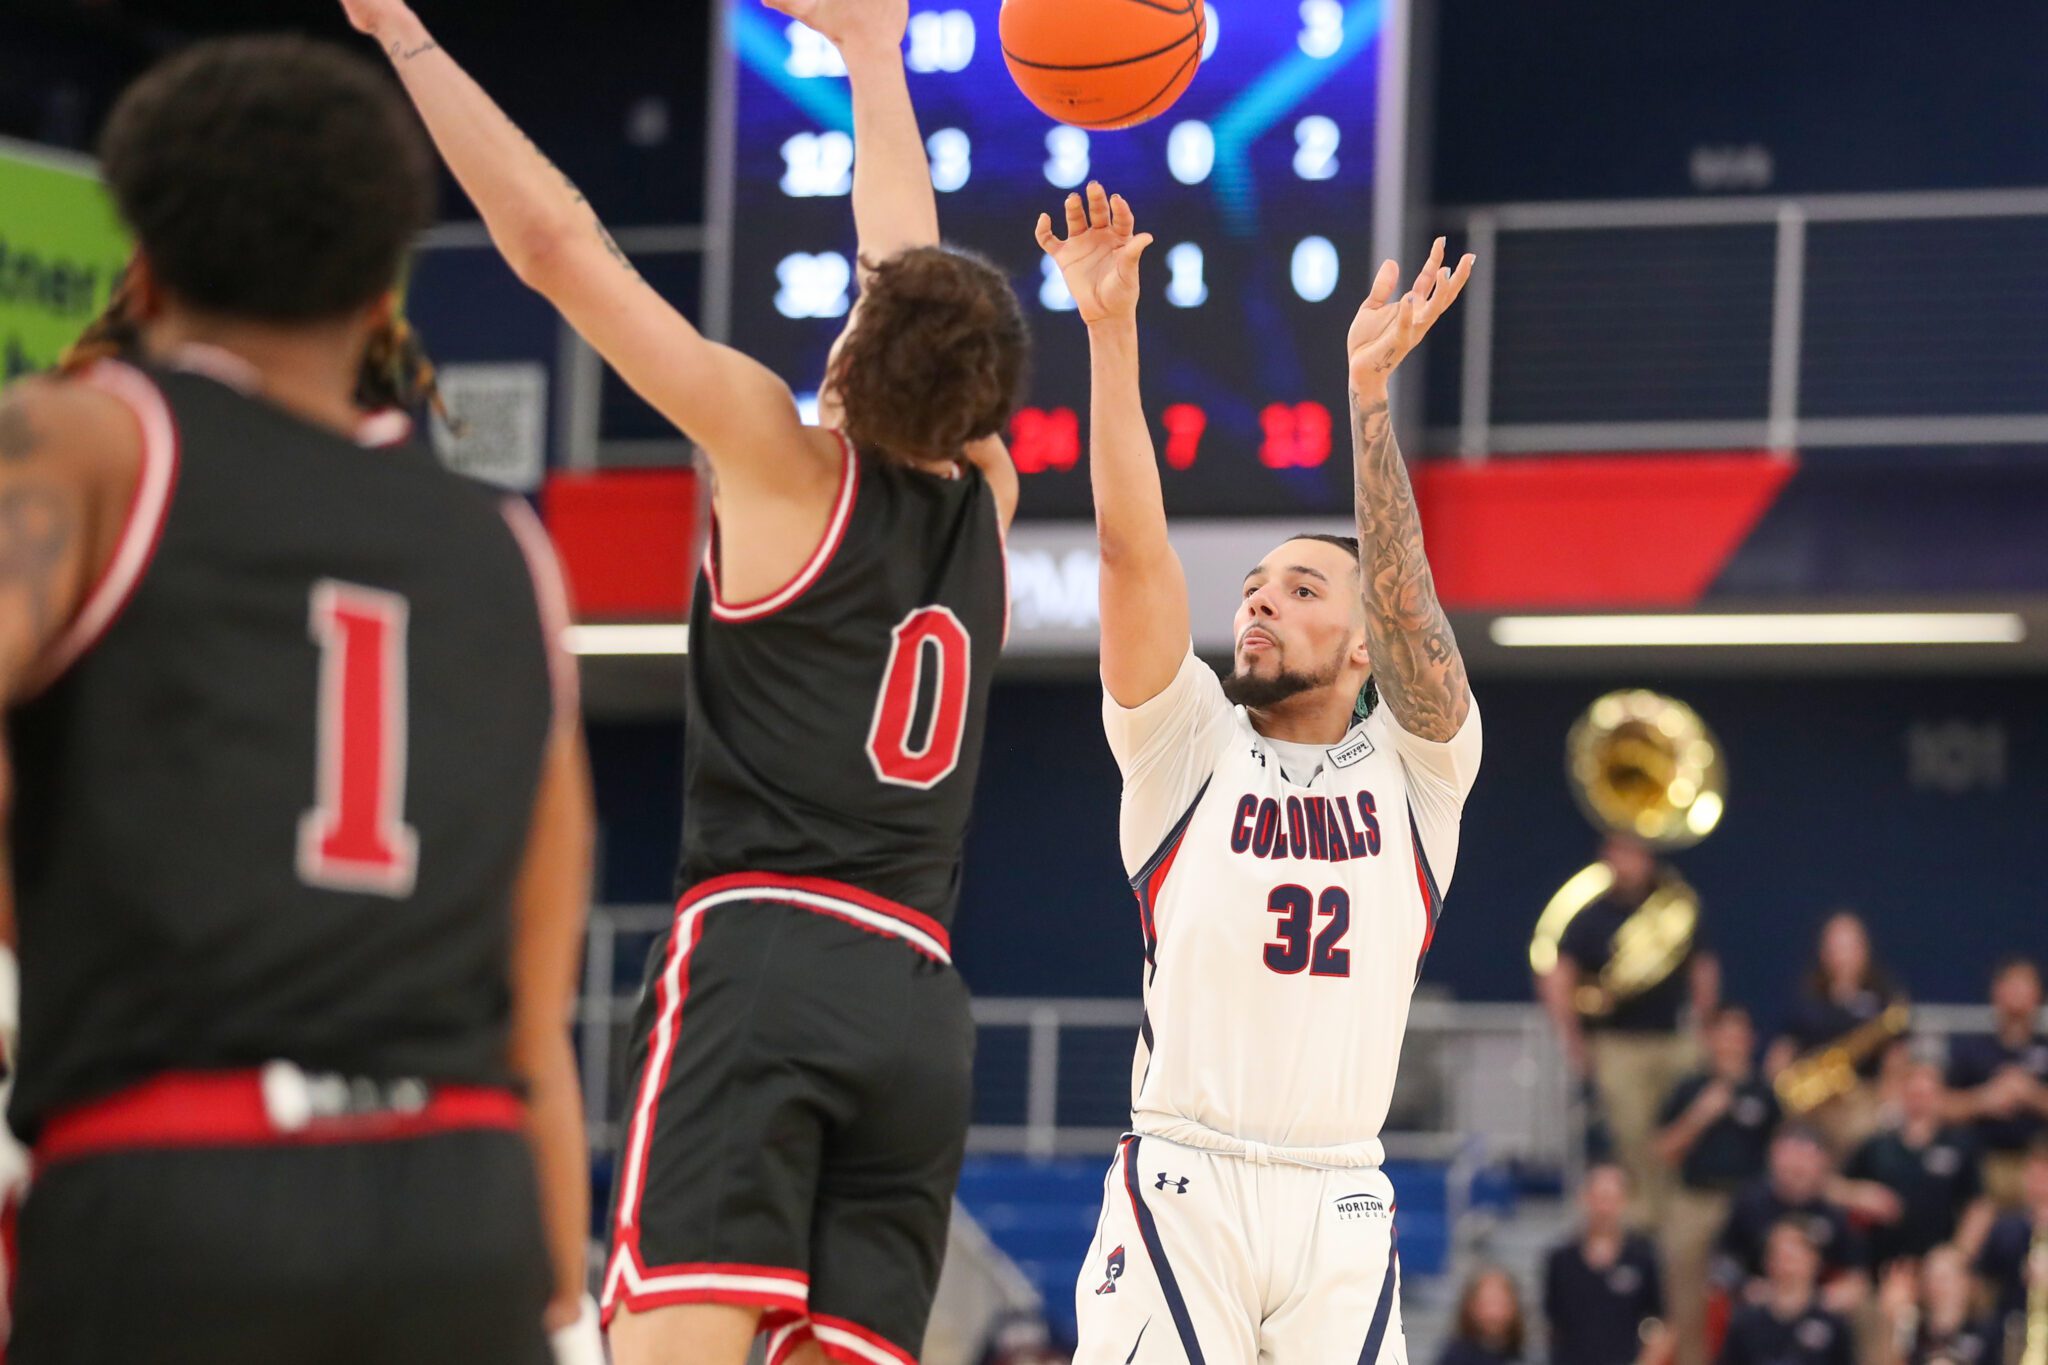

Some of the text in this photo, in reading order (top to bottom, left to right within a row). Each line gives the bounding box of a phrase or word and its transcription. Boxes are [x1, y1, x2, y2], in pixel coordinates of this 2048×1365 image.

[295, 577, 420, 901] 1
[865, 604, 971, 790] 0
[1263, 883, 1350, 977] 32
[1337, 1201, 1384, 1213] HORIZON
